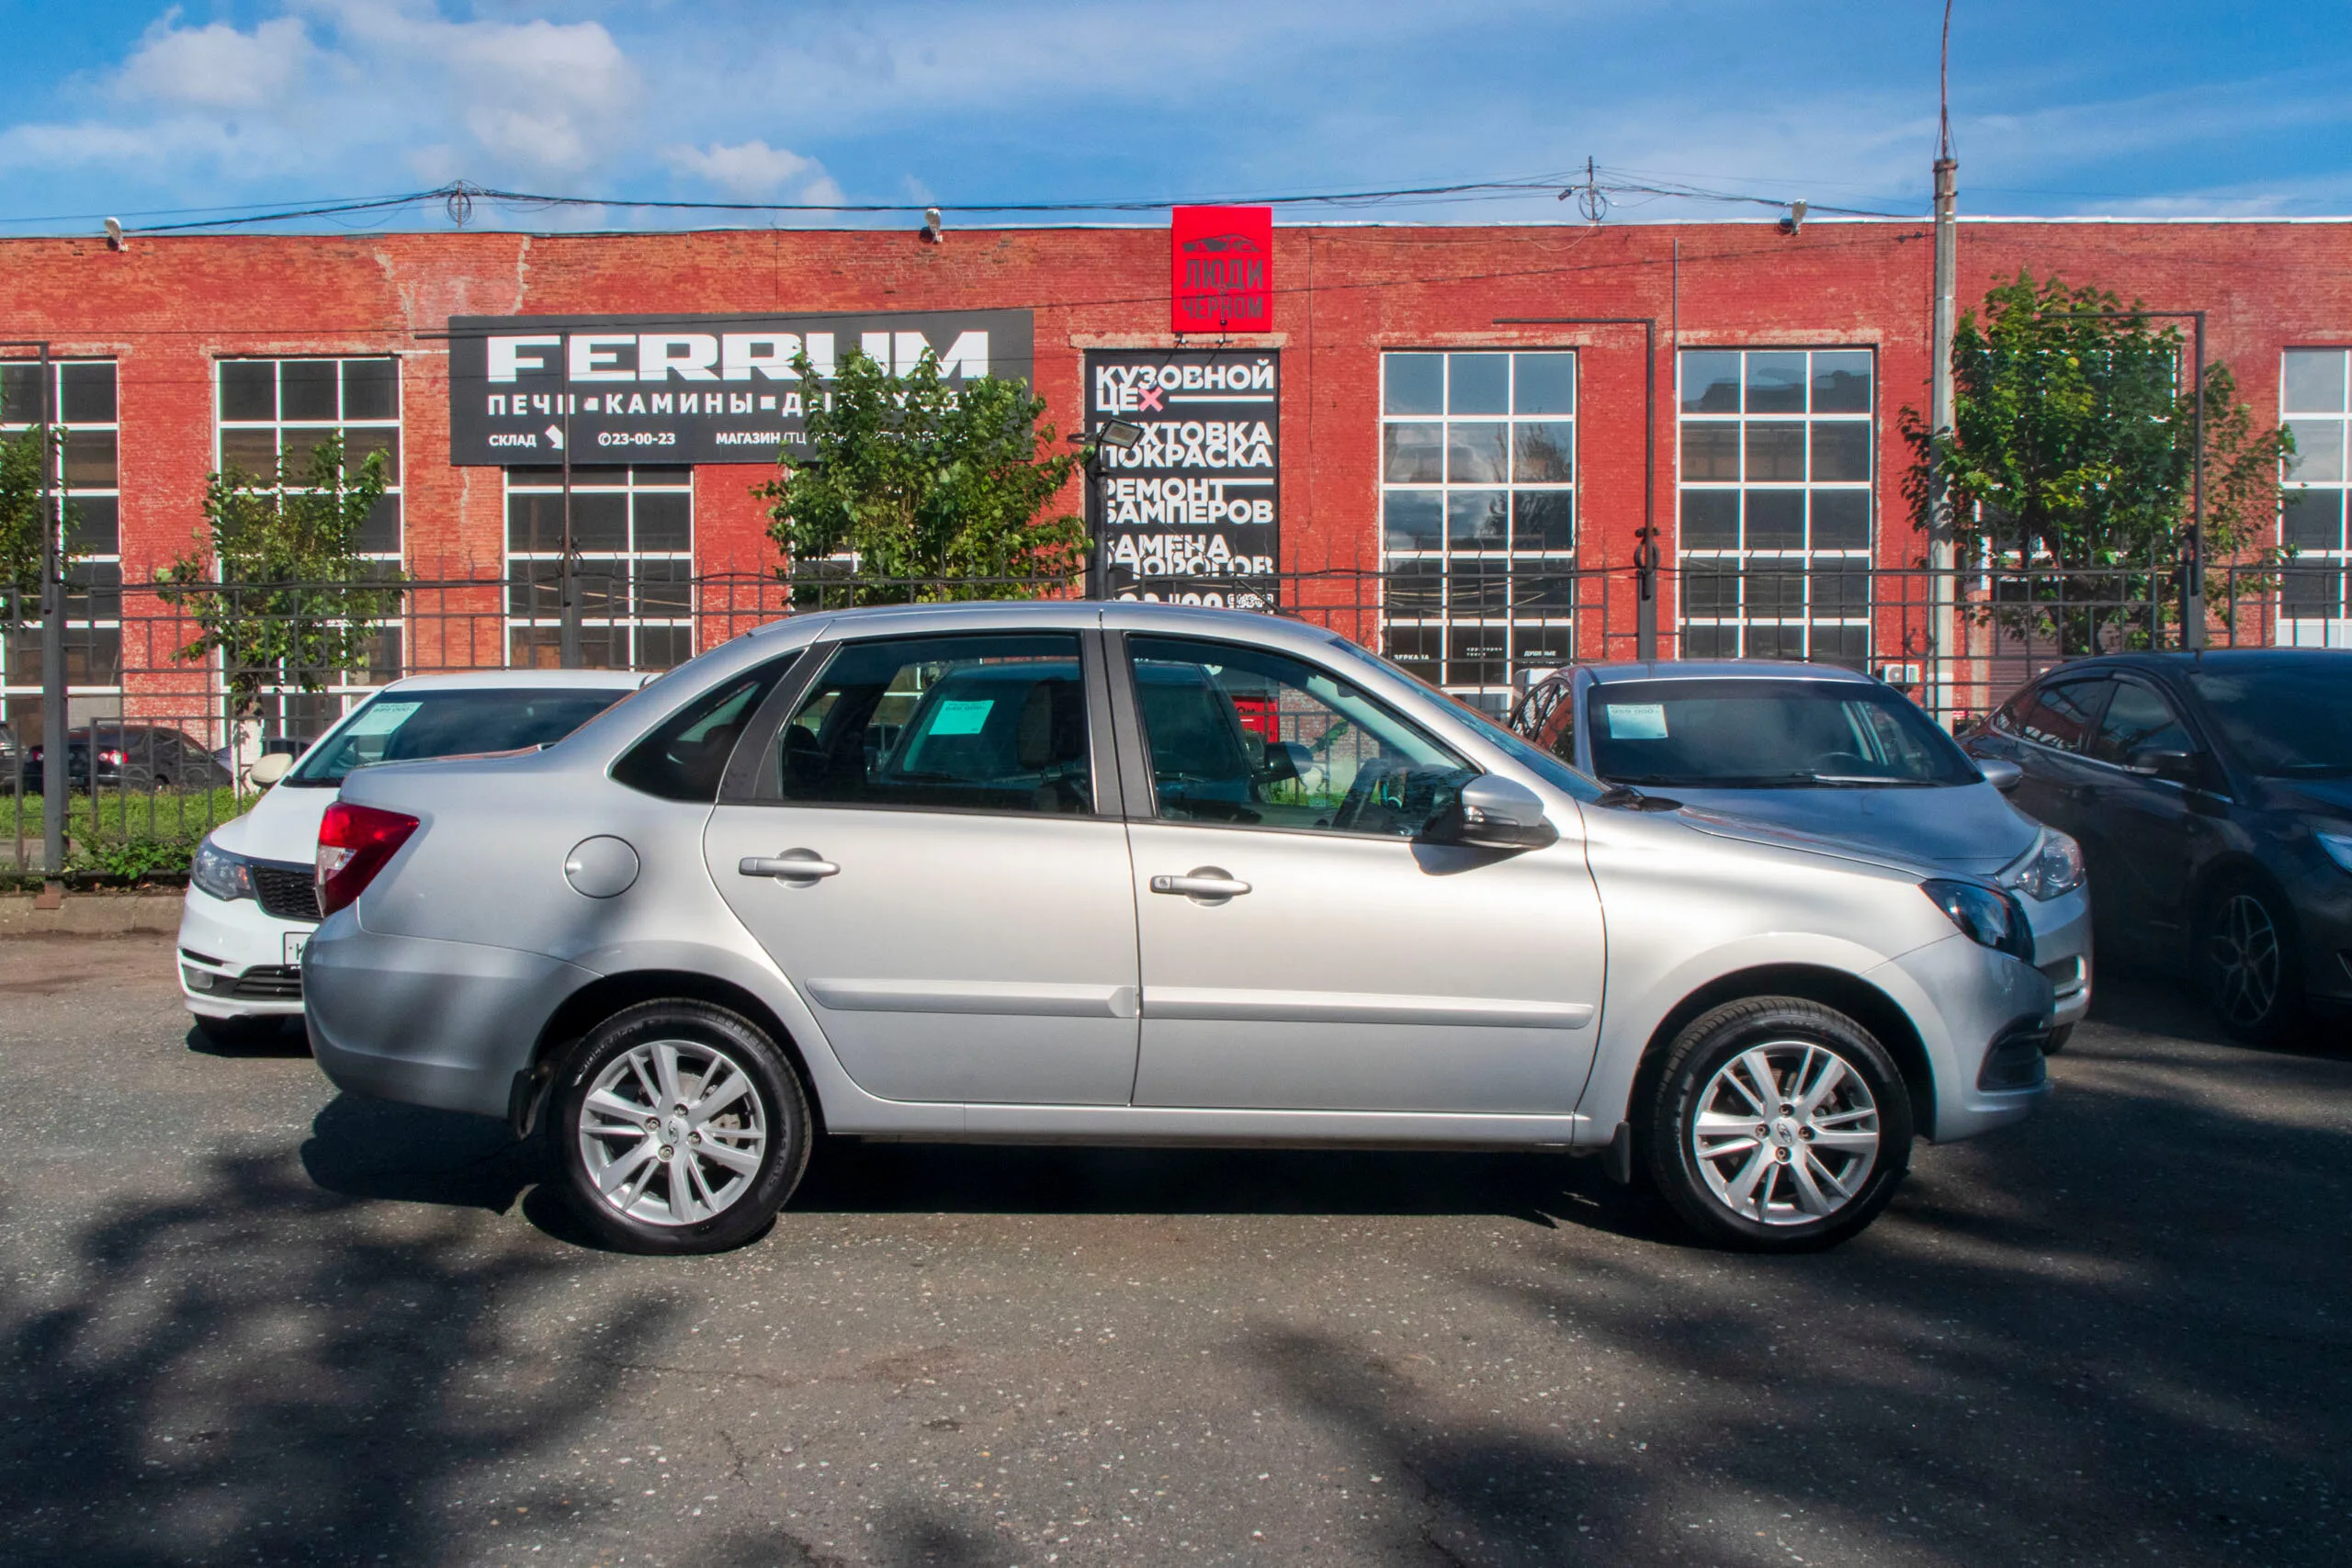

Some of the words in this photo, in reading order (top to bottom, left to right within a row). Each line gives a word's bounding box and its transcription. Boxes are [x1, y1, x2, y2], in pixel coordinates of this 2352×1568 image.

[1182, 259, 1263, 290] ЛЮДИ
[487, 332, 989, 382] FERRUM
[1096, 358, 1274, 390] КУЗОВНОЙ
[488, 393, 576, 415] ПЕЧИ
[605, 392, 752, 414] КАМИНЫ
[1096, 387, 1164, 415] ЦЕХ
[488, 434, 537, 447] СКЛАД
[716, 431, 781, 445] МАГАЗИН
[1096, 422, 1273, 446] ХТОВКА
[1107, 534, 1230, 559] АМЕНА
